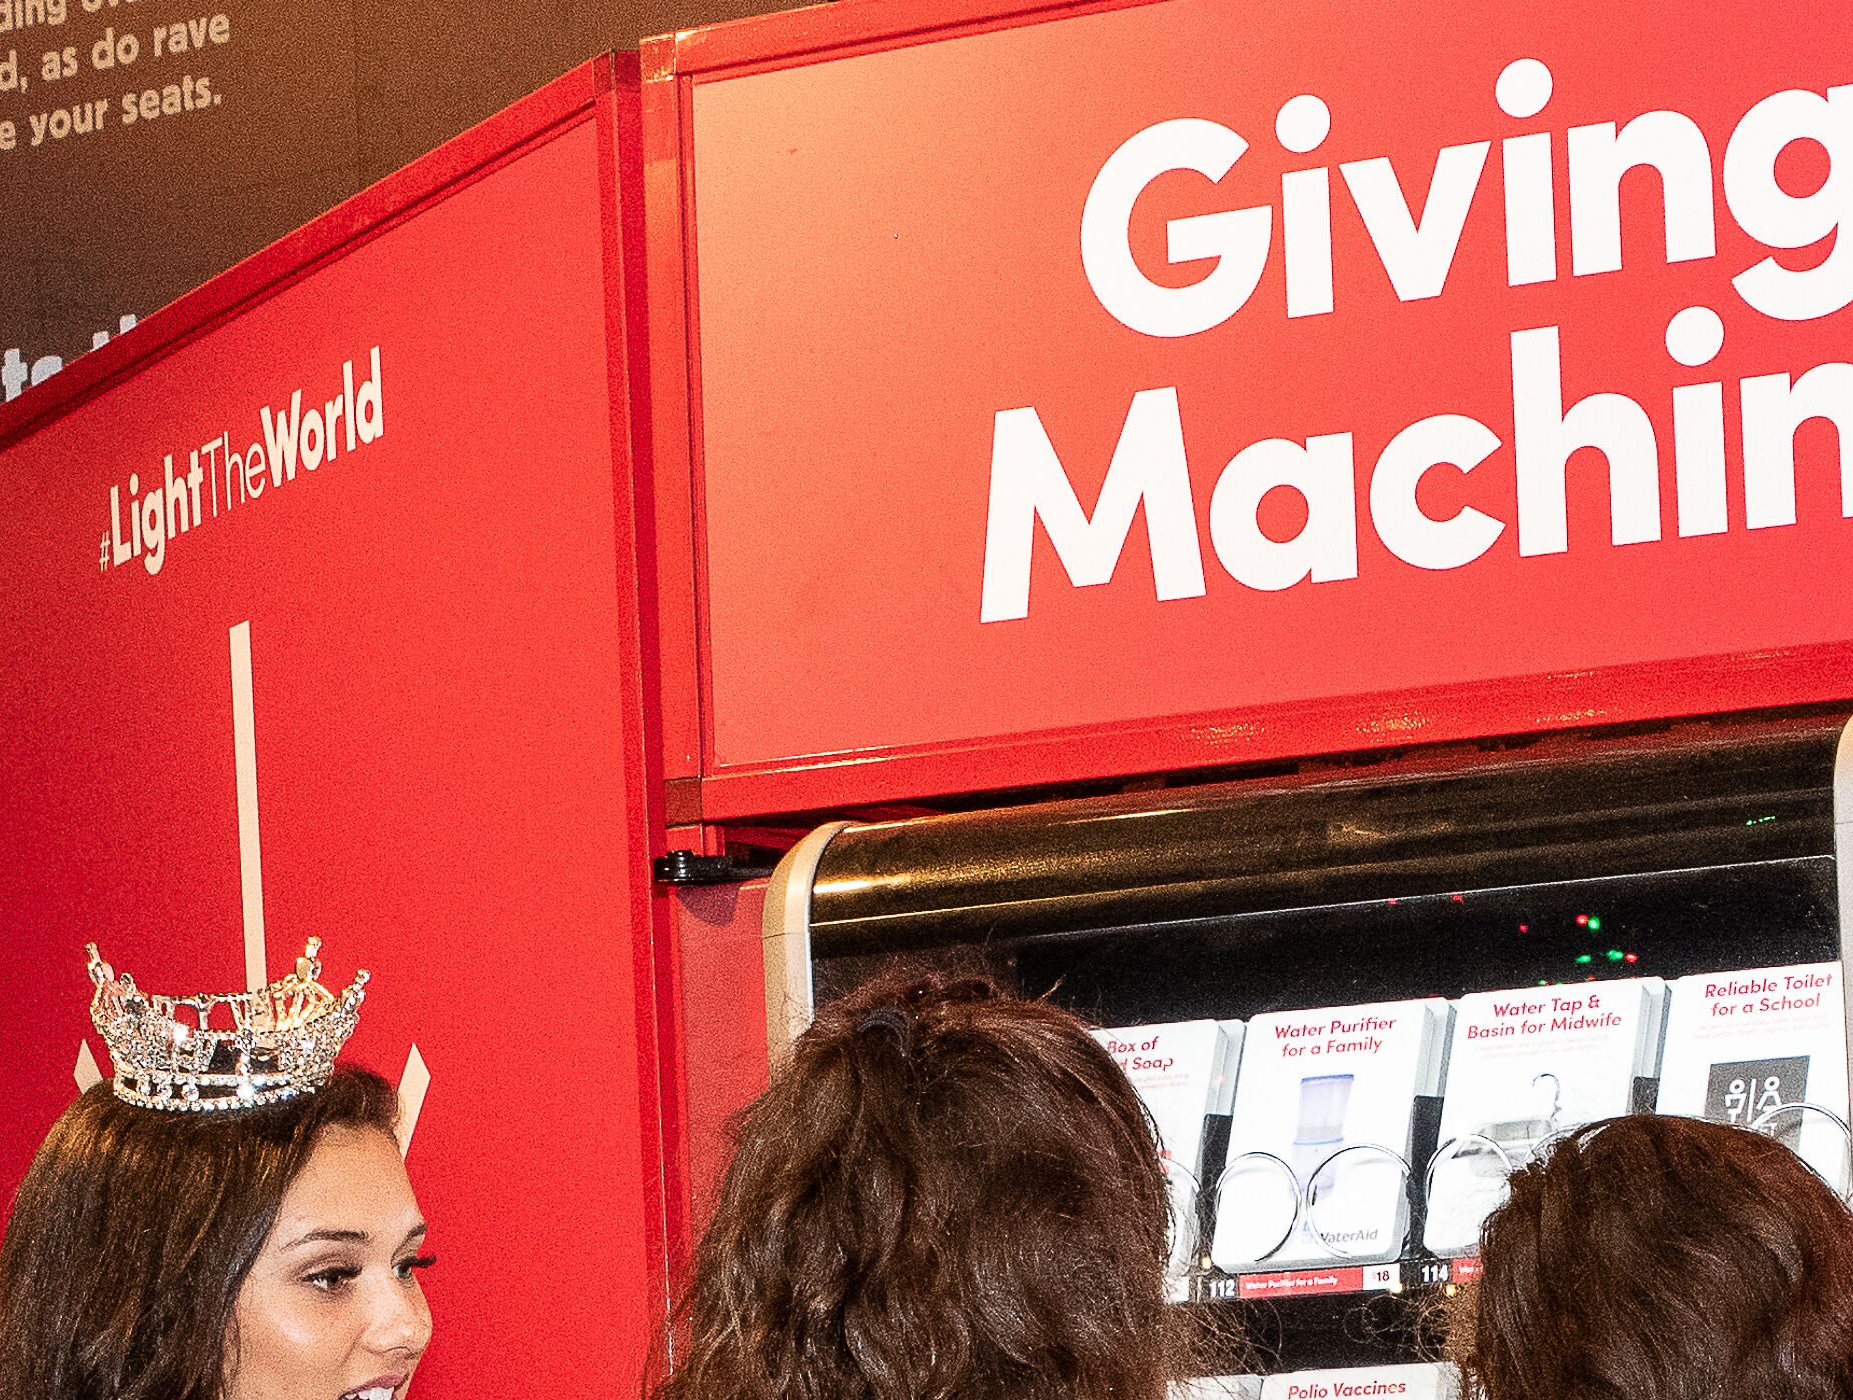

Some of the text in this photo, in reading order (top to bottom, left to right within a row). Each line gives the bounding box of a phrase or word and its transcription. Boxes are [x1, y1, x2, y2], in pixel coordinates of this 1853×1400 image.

[42, 46, 78, 81] as
[91, 27, 139, 70] do
[153, 14, 230, 57] rave
[29, 98, 110, 147] your
[121, 74, 222, 124] seats.
[98, 345, 385, 576] #LightTheWorld
[1705, 974, 1833, 998] Reliable Toilet
[1493, 994, 1600, 1018] Water Tap &
[1711, 993, 1821, 1017] for a School
[1275, 1017, 1397, 1039] Water Purifier
[1467, 1012, 1623, 1040] Basin for Midwife
[1141, 1036, 1160, 1051] of
[1281, 1036, 1383, 1058] for a Family
[1421, 1264, 1449, 1283] 114
[1209, 1280, 1236, 1298] 112
[1288, 1380, 1407, 1400] Polio Vaccines
